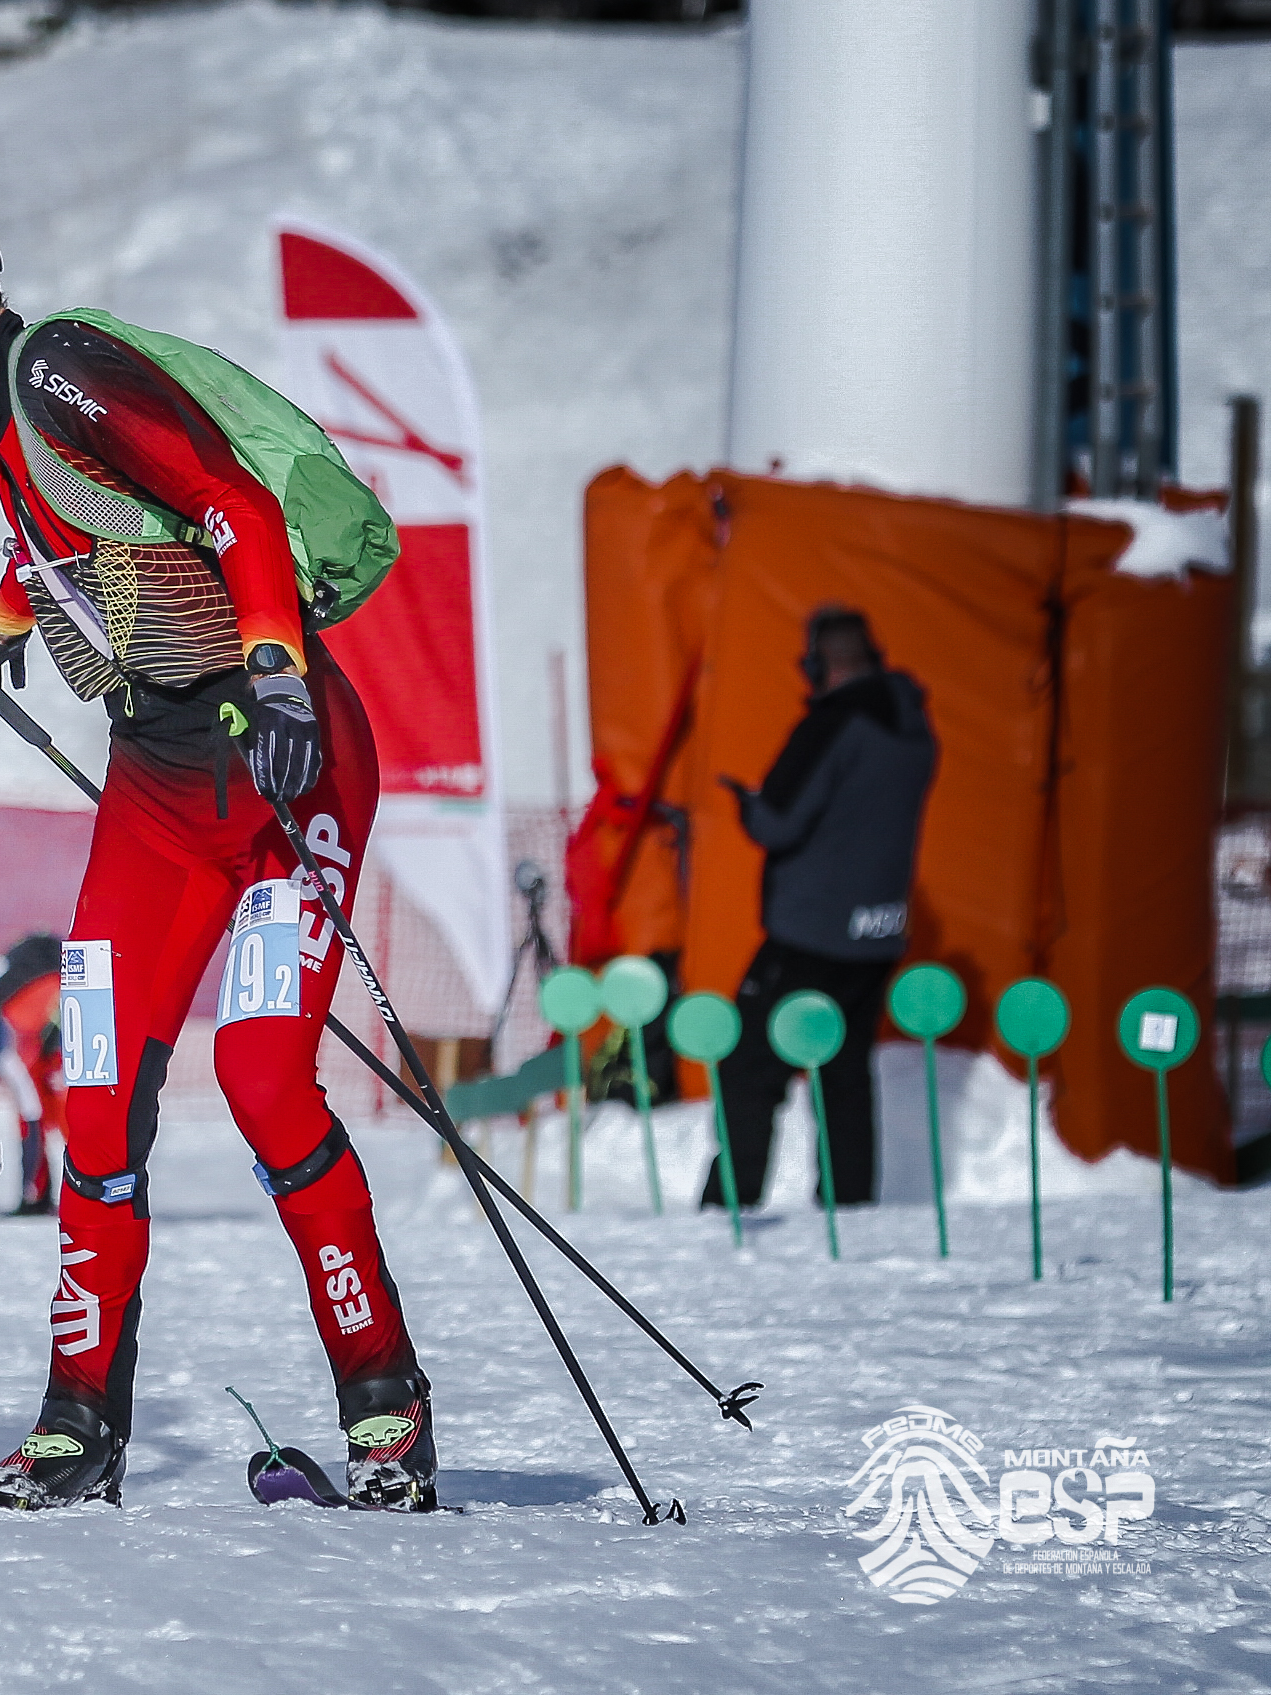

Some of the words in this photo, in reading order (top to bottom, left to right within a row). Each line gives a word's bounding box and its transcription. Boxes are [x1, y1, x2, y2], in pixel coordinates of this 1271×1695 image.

[43, 373, 108, 422] SISMIC
[256, 732, 265, 788] DYNAFIT
[251, 900, 271, 913] ISMF
[291, 813, 351, 962] ESP
[222, 932, 292, 1022] 19.2
[337, 929, 396, 1022] DYNAFIT
[63, 995, 110, 1081] 9.2
[319, 1244, 372, 1328] ESP
[341, 1317, 375, 1336] FEDME
